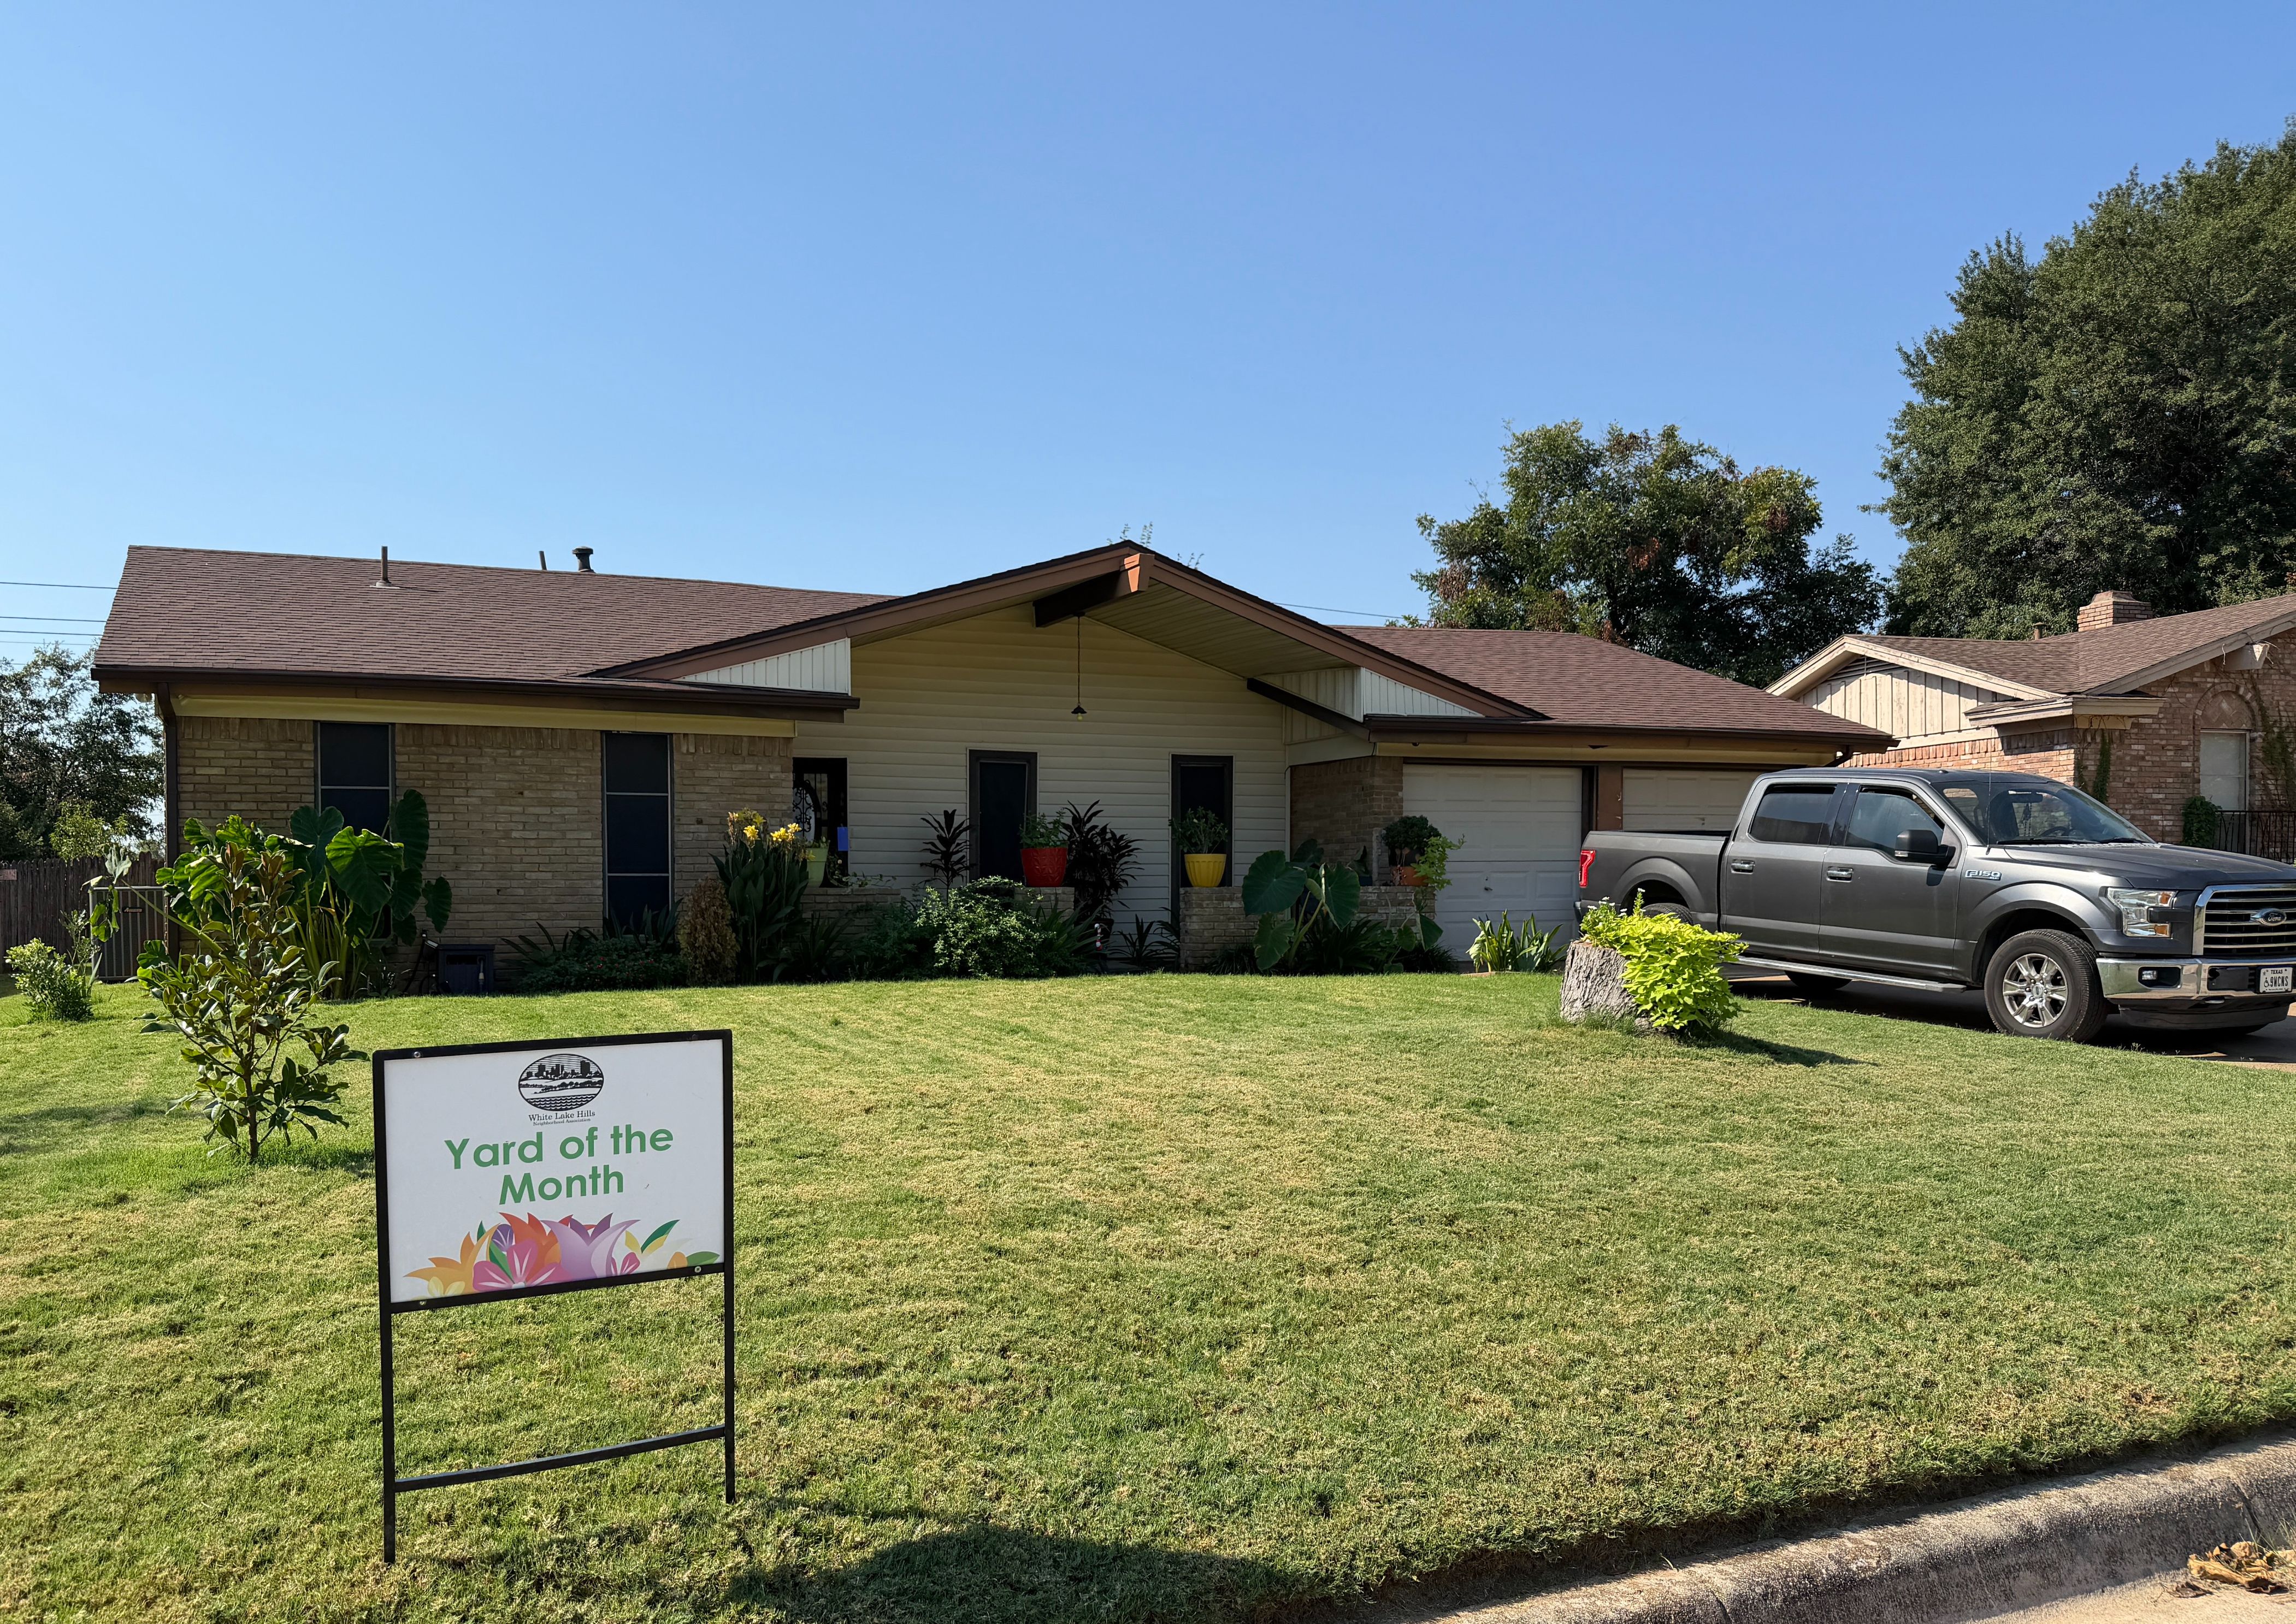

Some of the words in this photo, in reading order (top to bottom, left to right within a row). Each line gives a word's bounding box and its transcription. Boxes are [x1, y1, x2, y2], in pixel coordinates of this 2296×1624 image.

[528, 1113, 553, 1121] White
[555, 1112, 575, 1120] Lake
[445, 1132, 542, 1170] Yard
[560, 1126, 598, 1159] of
[610, 1124, 674, 1155] the
[499, 1165, 624, 1205] Month
